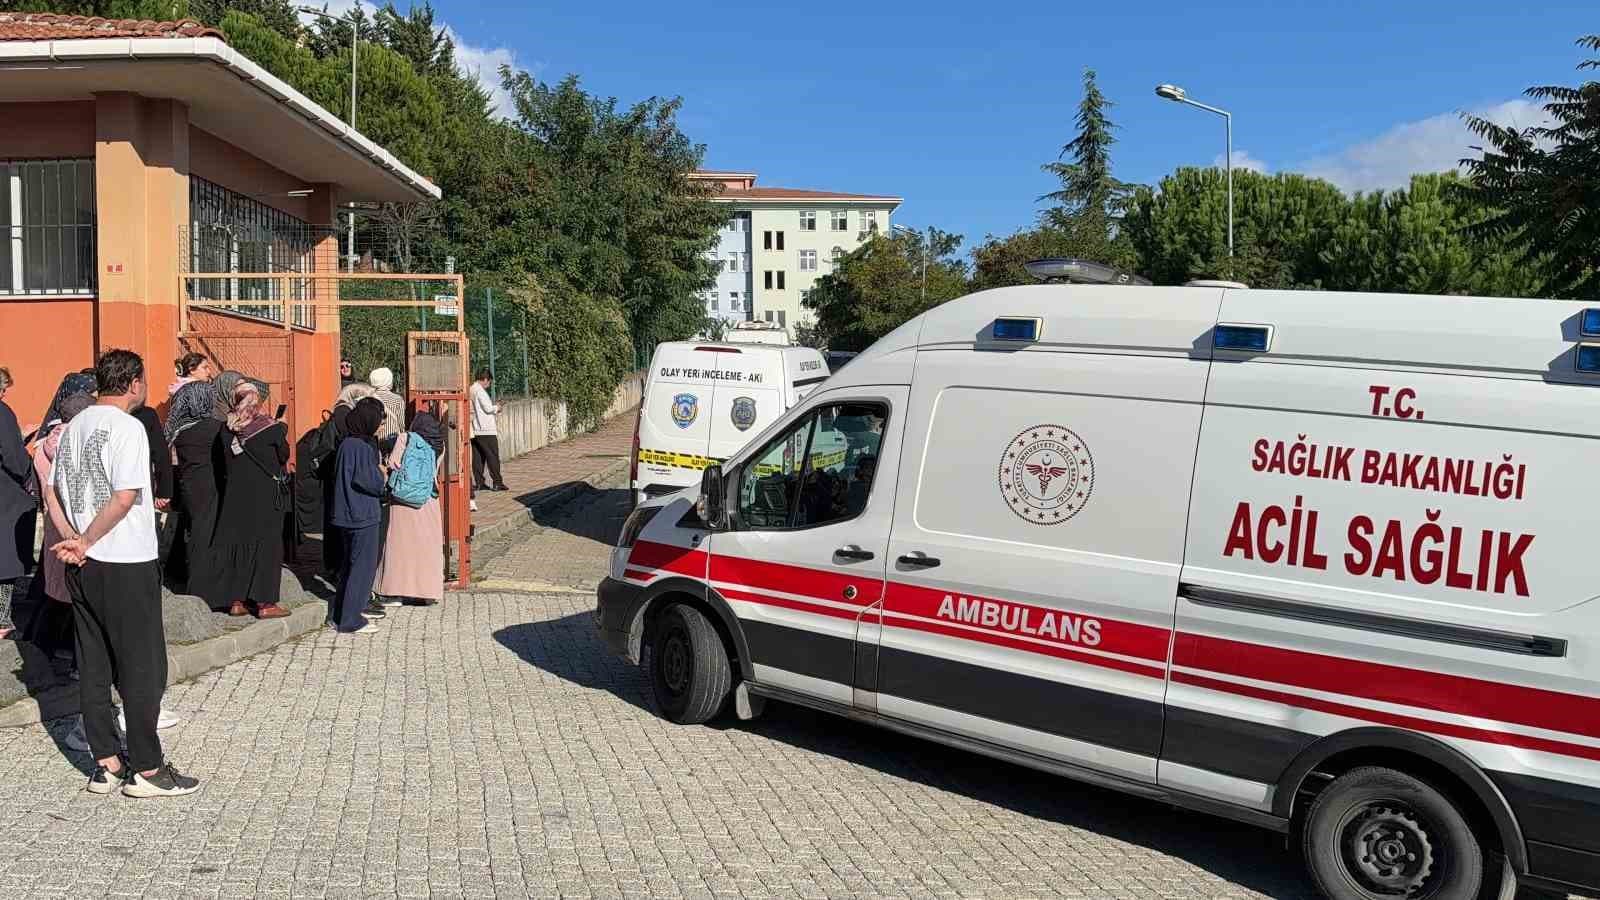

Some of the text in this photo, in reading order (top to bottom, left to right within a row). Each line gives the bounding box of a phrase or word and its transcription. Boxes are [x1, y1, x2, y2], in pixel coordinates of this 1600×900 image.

[661, 367, 680, 377] OLAY
[682, 368, 700, 379] YERİ
[701, 369, 742, 381] İNCELEME
[1368, 385, 1424, 420] T.C.
[1252, 433, 1526, 501] SAĞLIK BAKANLIĞI
[1223, 495, 1536, 597] ACİL SAĞLIK
[936, 594, 1102, 646] AMBULANS
